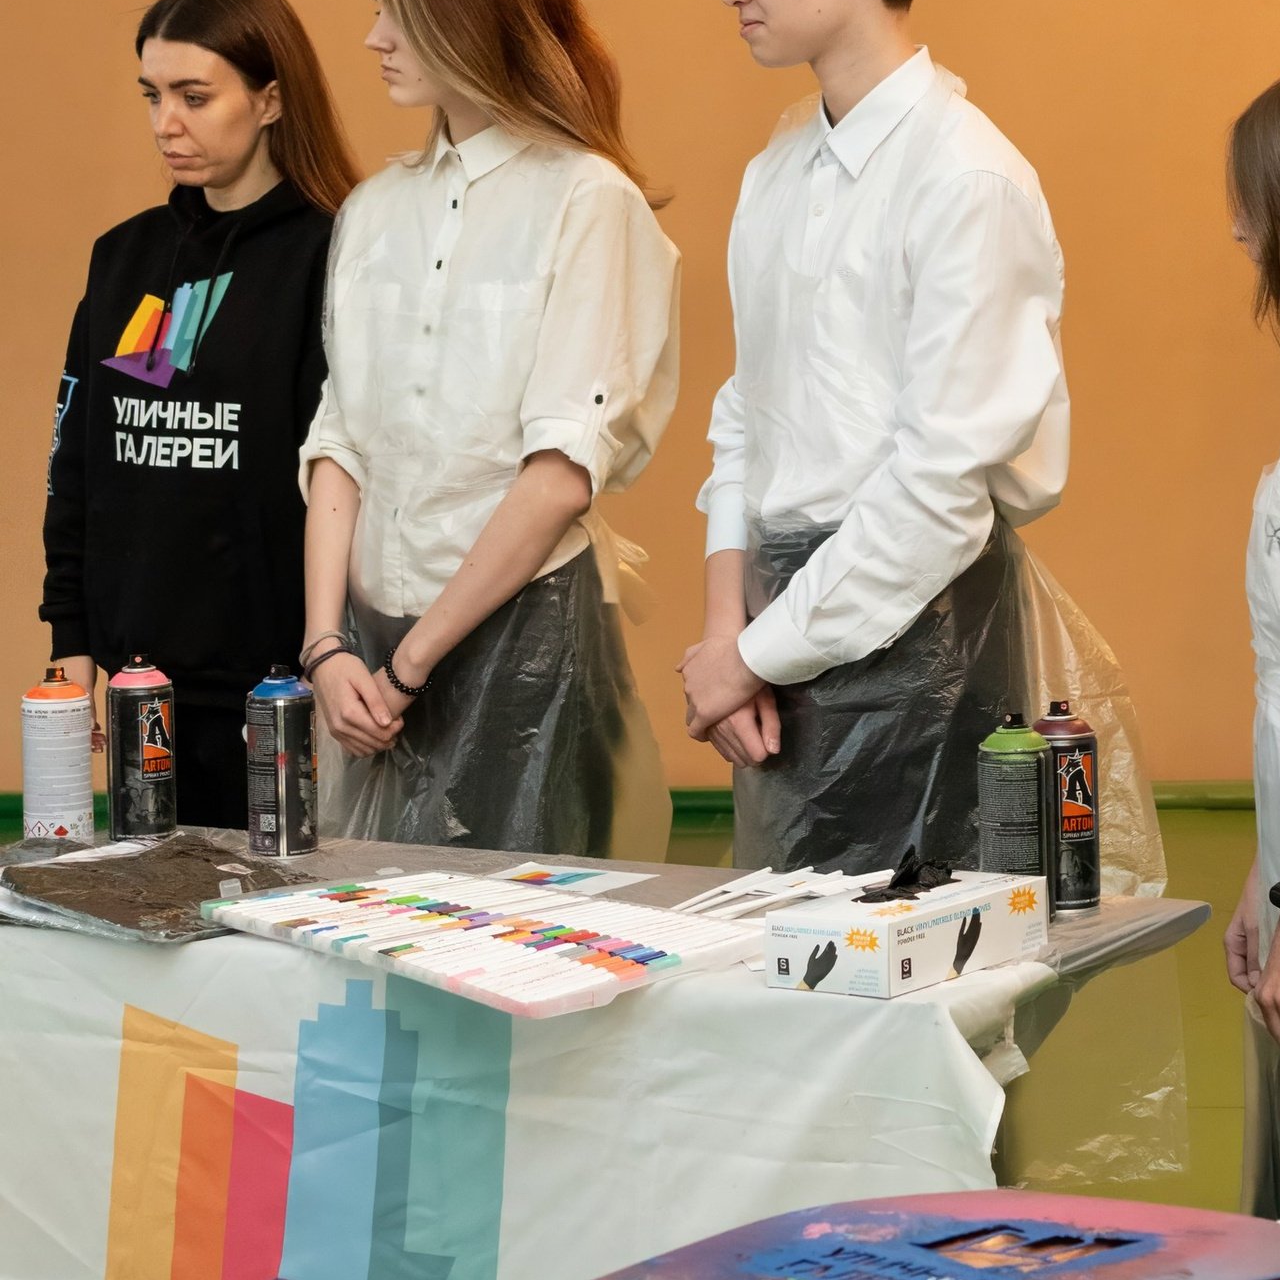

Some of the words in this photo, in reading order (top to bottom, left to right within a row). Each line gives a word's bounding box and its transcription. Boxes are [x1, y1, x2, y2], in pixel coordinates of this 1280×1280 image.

[113, 396, 241, 432] УЛИЧНЫЕ
[115, 431, 239, 470] ГАЛЕРЕИ
[143, 758, 171, 773] ARTON
[1063, 817, 1093, 832] ARTON
[896, 925, 914, 937] BLACK
[780, 959, 787, 970] S
[903, 960, 910, 972] S
